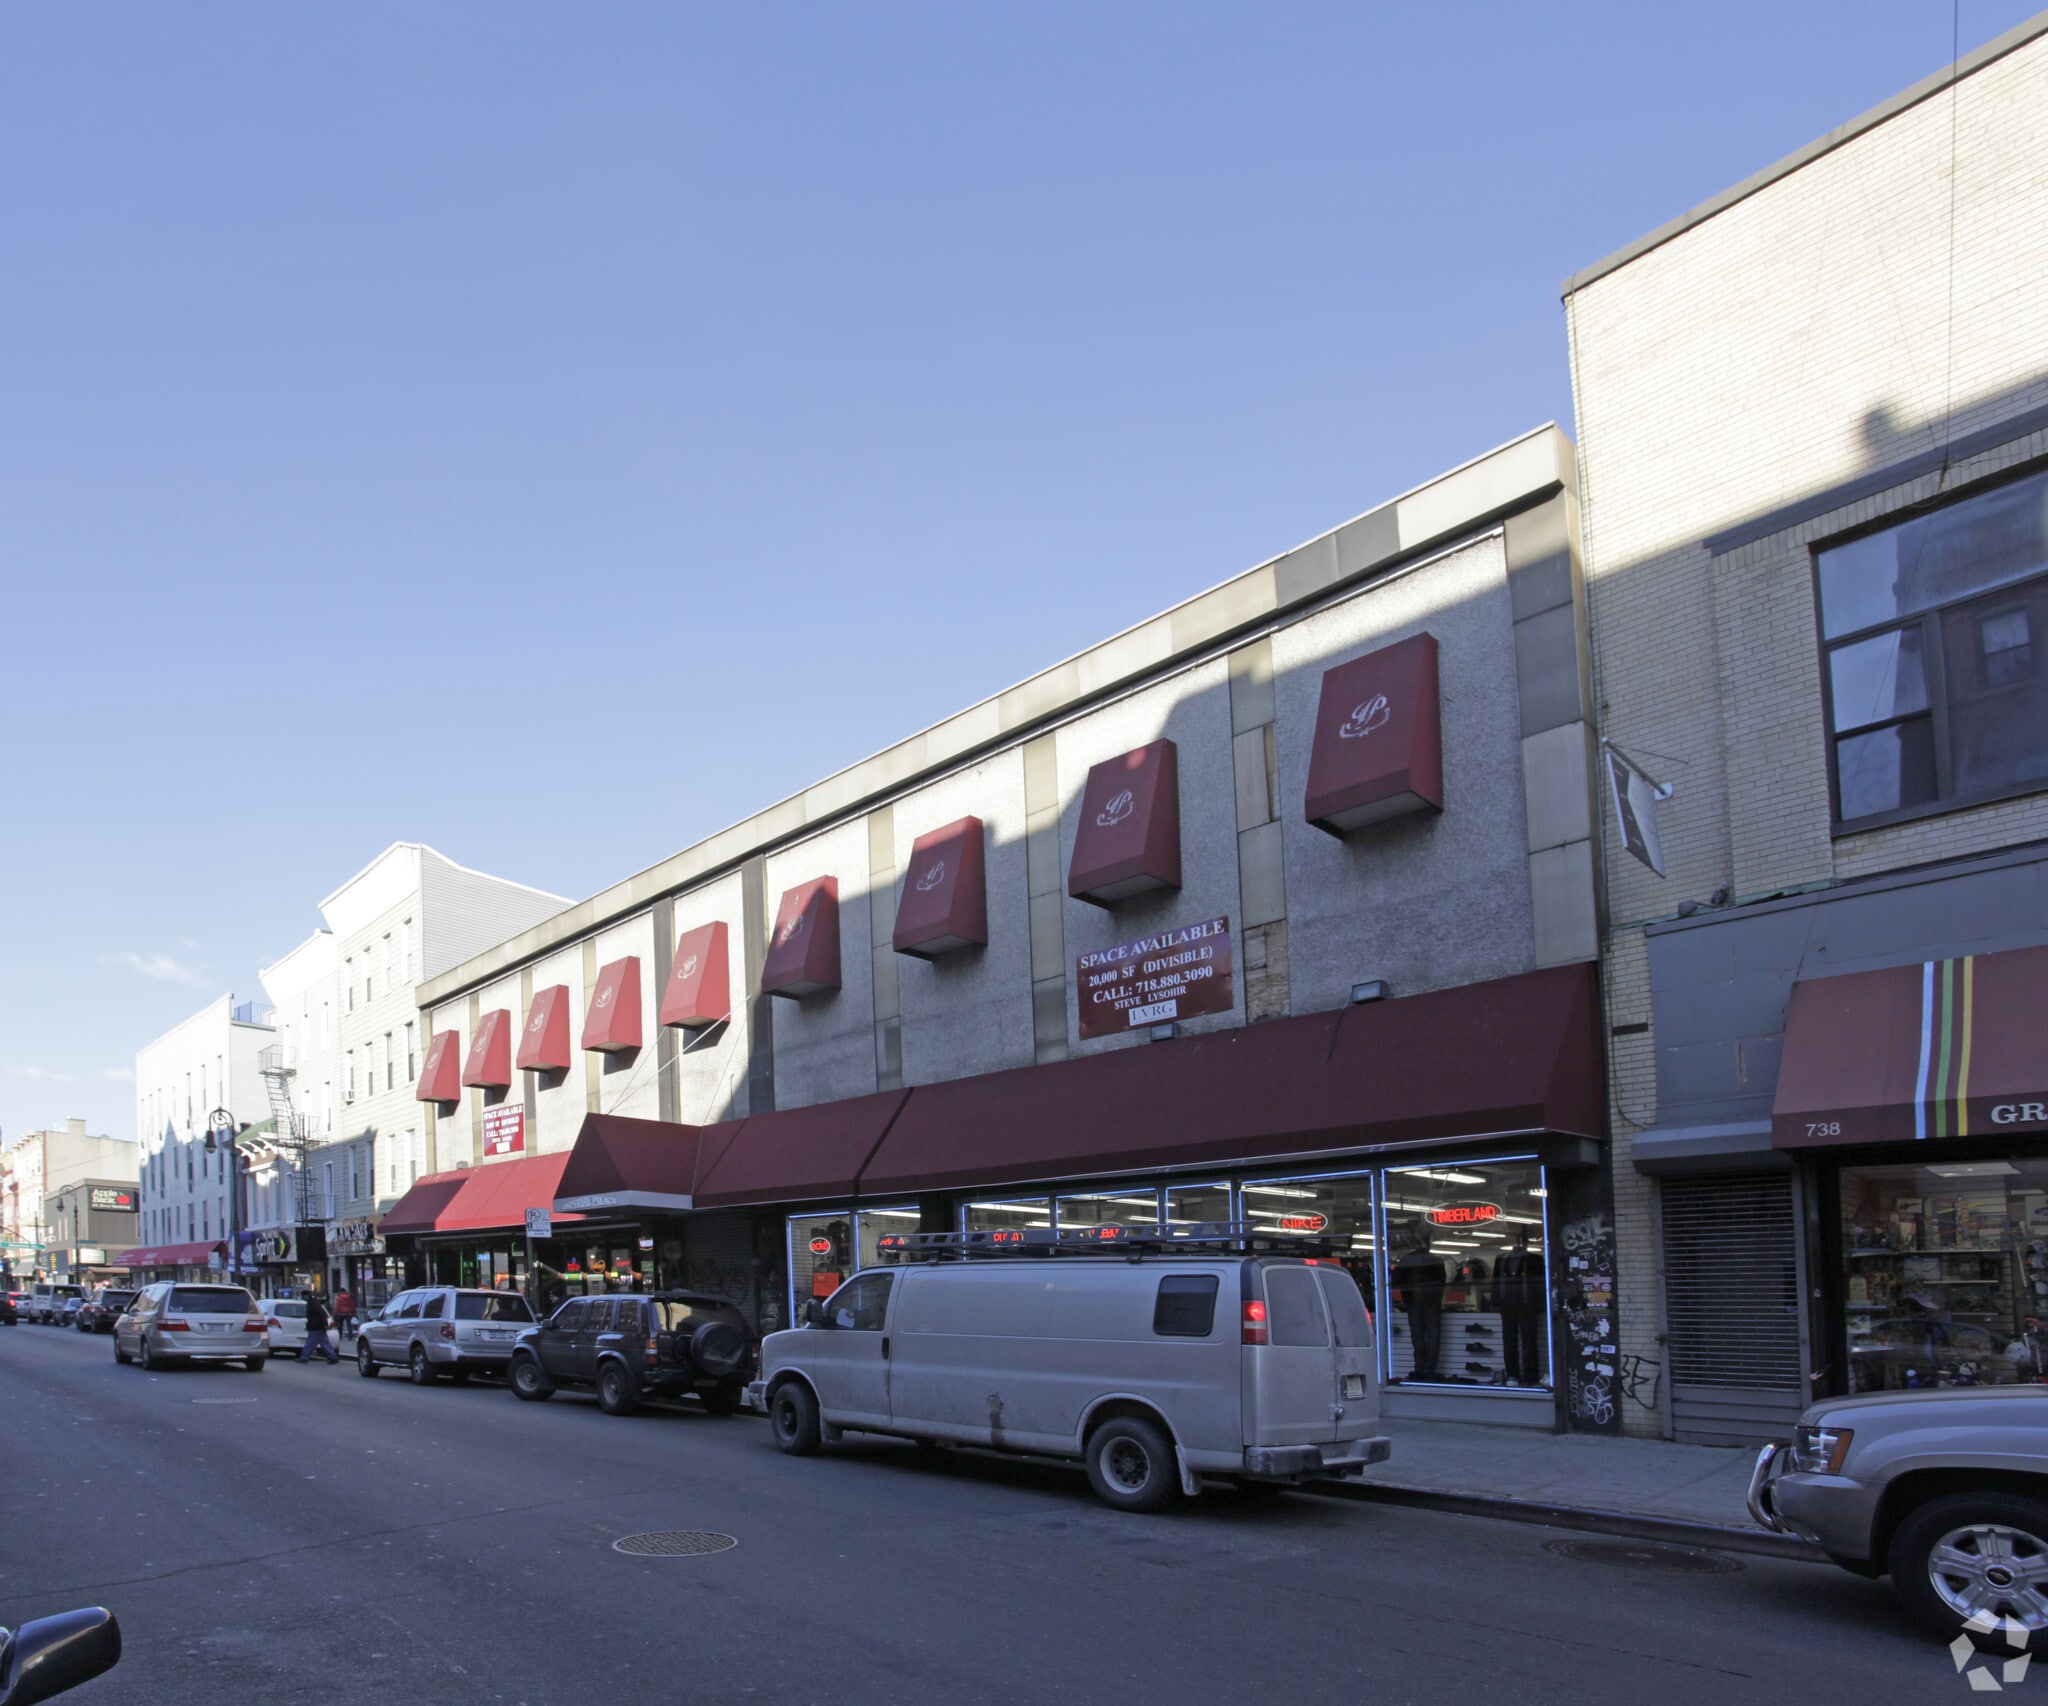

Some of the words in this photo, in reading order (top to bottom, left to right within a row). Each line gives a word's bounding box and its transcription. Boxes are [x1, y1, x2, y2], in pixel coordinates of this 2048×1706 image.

[1080, 946, 1128, 969] SPACE
[1130, 919, 1225, 956] AVAILABLE
[1088, 970, 1118, 987] 20,000
[1122, 965, 1136, 979] SF
[1143, 945, 1213, 974] (DIVISIBLE)
[1093, 985, 1133, 1003] CALL:
[1136, 965, 1213, 994] 718.880.3090
[1114, 996, 1142, 1010] STEVE
[1147, 985, 1187, 1003] LYSOHIR
[1805, 1122, 1841, 1137] 738
[91, 1188, 118, 1198] Apple
[1281, 1215, 1323, 1230] NIKE
[1430, 1206, 1497, 1224] TIMBERLAND
